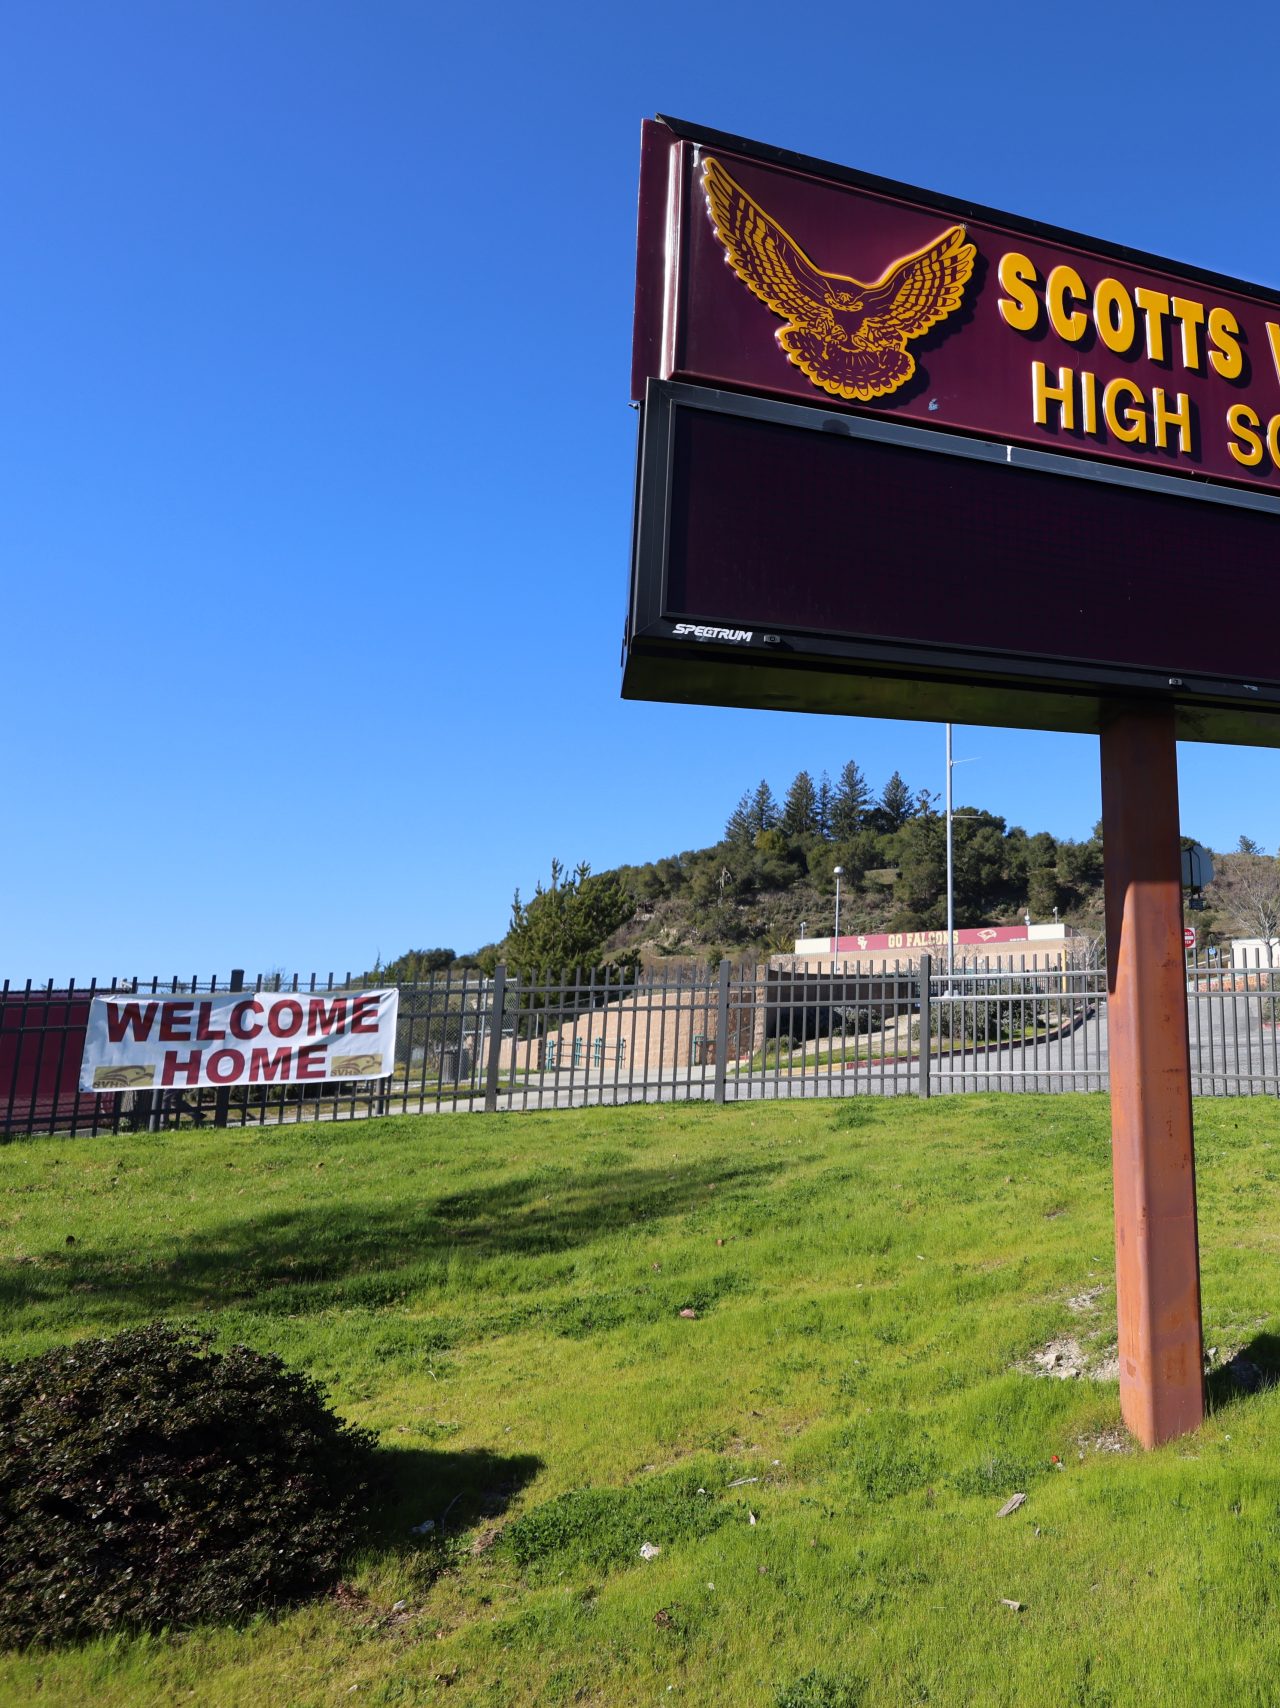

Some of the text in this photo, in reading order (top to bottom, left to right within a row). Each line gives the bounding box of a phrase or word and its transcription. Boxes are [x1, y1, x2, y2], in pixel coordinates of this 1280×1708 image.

[998, 252, 1243, 380] SCOTTS
[1032, 361, 1192, 453] HIGH
[672, 623, 753, 642] SPECTRUM
[888, 933, 903, 948] GO
[107, 996, 381, 1043] WELCOME
[161, 1044, 328, 1086] HOME
